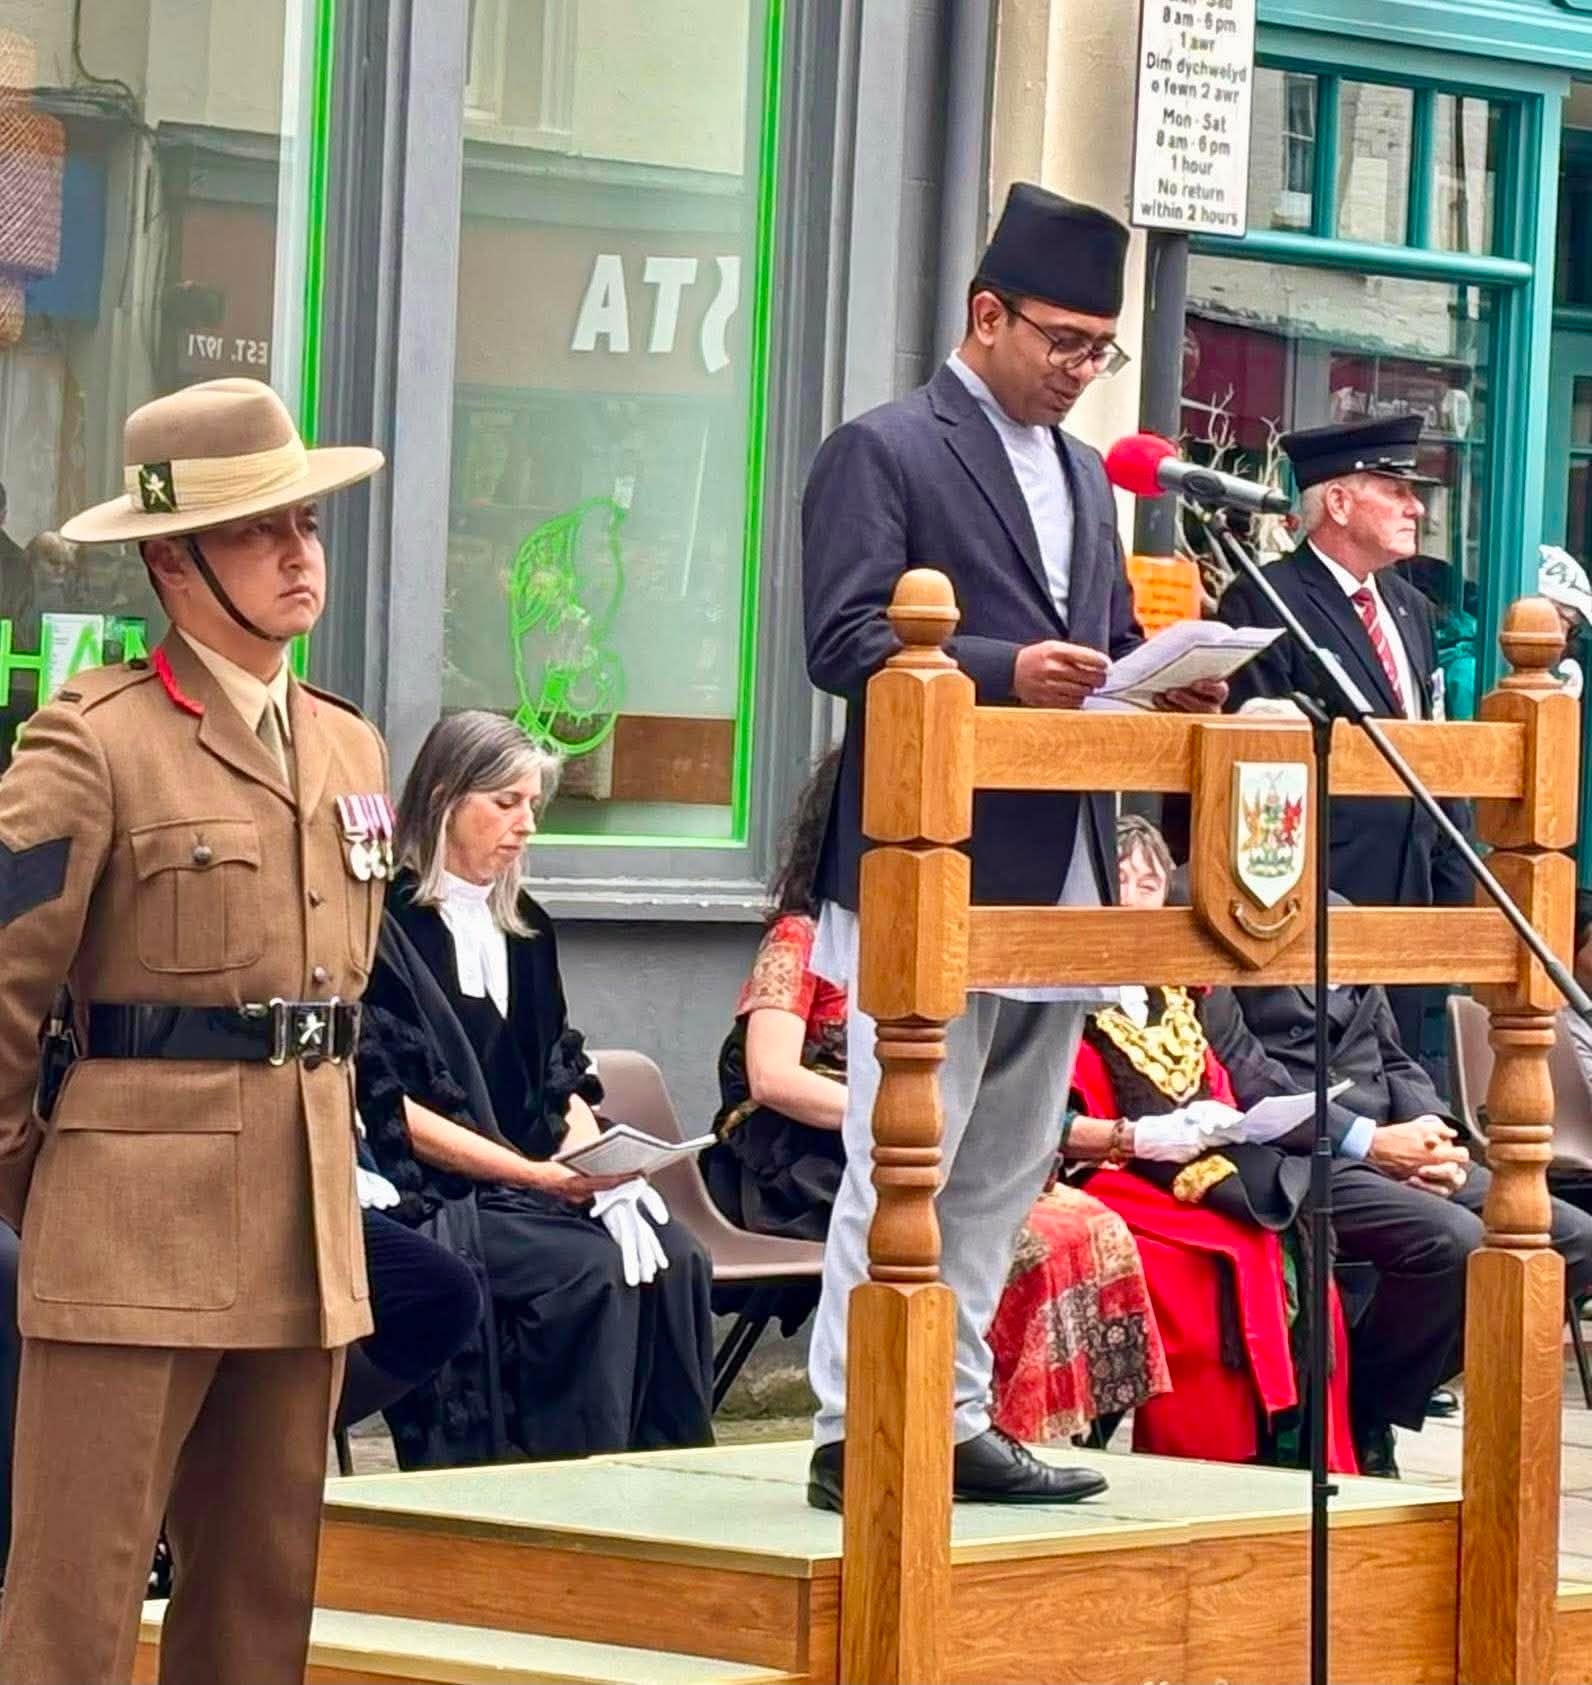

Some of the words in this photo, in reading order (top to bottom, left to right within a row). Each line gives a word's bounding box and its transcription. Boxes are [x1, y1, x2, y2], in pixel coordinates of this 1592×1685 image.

[1163, 6, 1171, 23] 8
[1174, 11, 1194, 27] am
[1204, 11, 1213, 30] 6
[1215, 18, 1236, 34] pm
[1181, 31, 1186, 48] 1
[1190, 37, 1215, 52] awr
[1146, 52, 1172, 71] Dim
[1176, 57, 1247, 84] dychwelyd
[1151, 79, 1160, 93] o
[1164, 77, 1197, 99] fewn
[1201, 82, 1211, 99] 2
[1214, 88, 1240, 104] awr
[1162, 107, 1192, 128] Mon
[1202, 113, 1226, 133] Sat
[1156, 128, 1165, 147] 8
[1168, 134, 1188, 150] am
[1199, 134, 1207, 152] 6
[1209, 140, 1231, 157] pm
[1171, 153, 1177, 171] 1
[1182, 155, 1213, 175] hour
[1158, 178, 1178, 196] No
[1181, 183, 1225, 202] return
[1141, 199, 1184, 220] within
[1187, 203, 1196, 221] 2
[1200, 205, 1238, 226] hours
